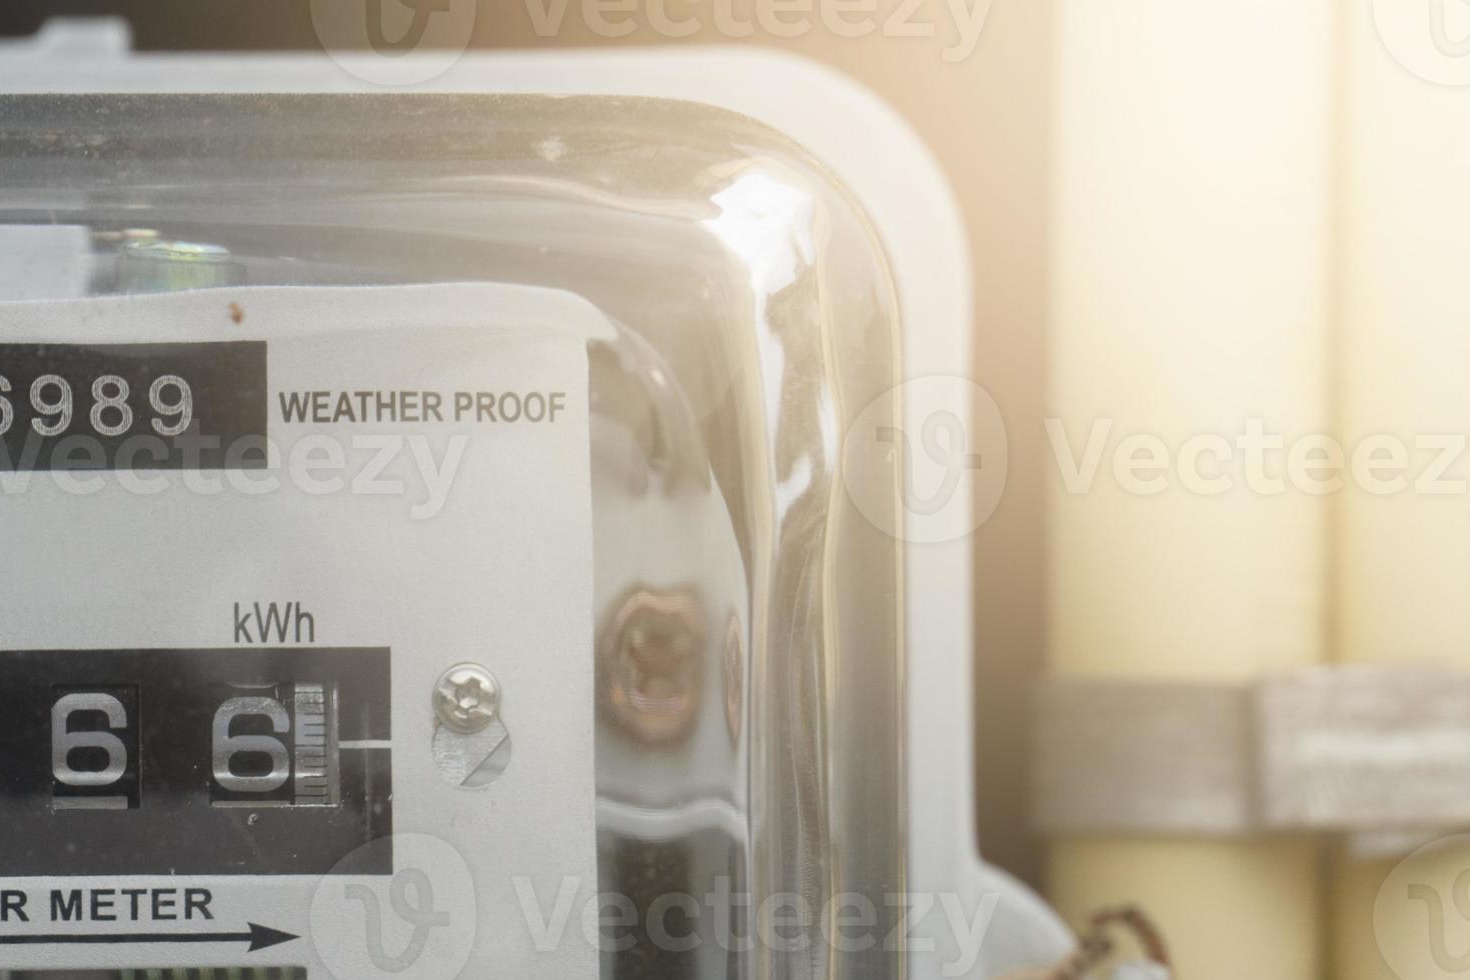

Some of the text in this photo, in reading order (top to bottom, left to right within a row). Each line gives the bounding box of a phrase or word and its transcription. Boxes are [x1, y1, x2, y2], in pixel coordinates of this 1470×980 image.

[279, 391, 566, 423] WEATHER PROOF
[233, 602, 316, 643] kWh
[49, 887, 215, 921] METER
